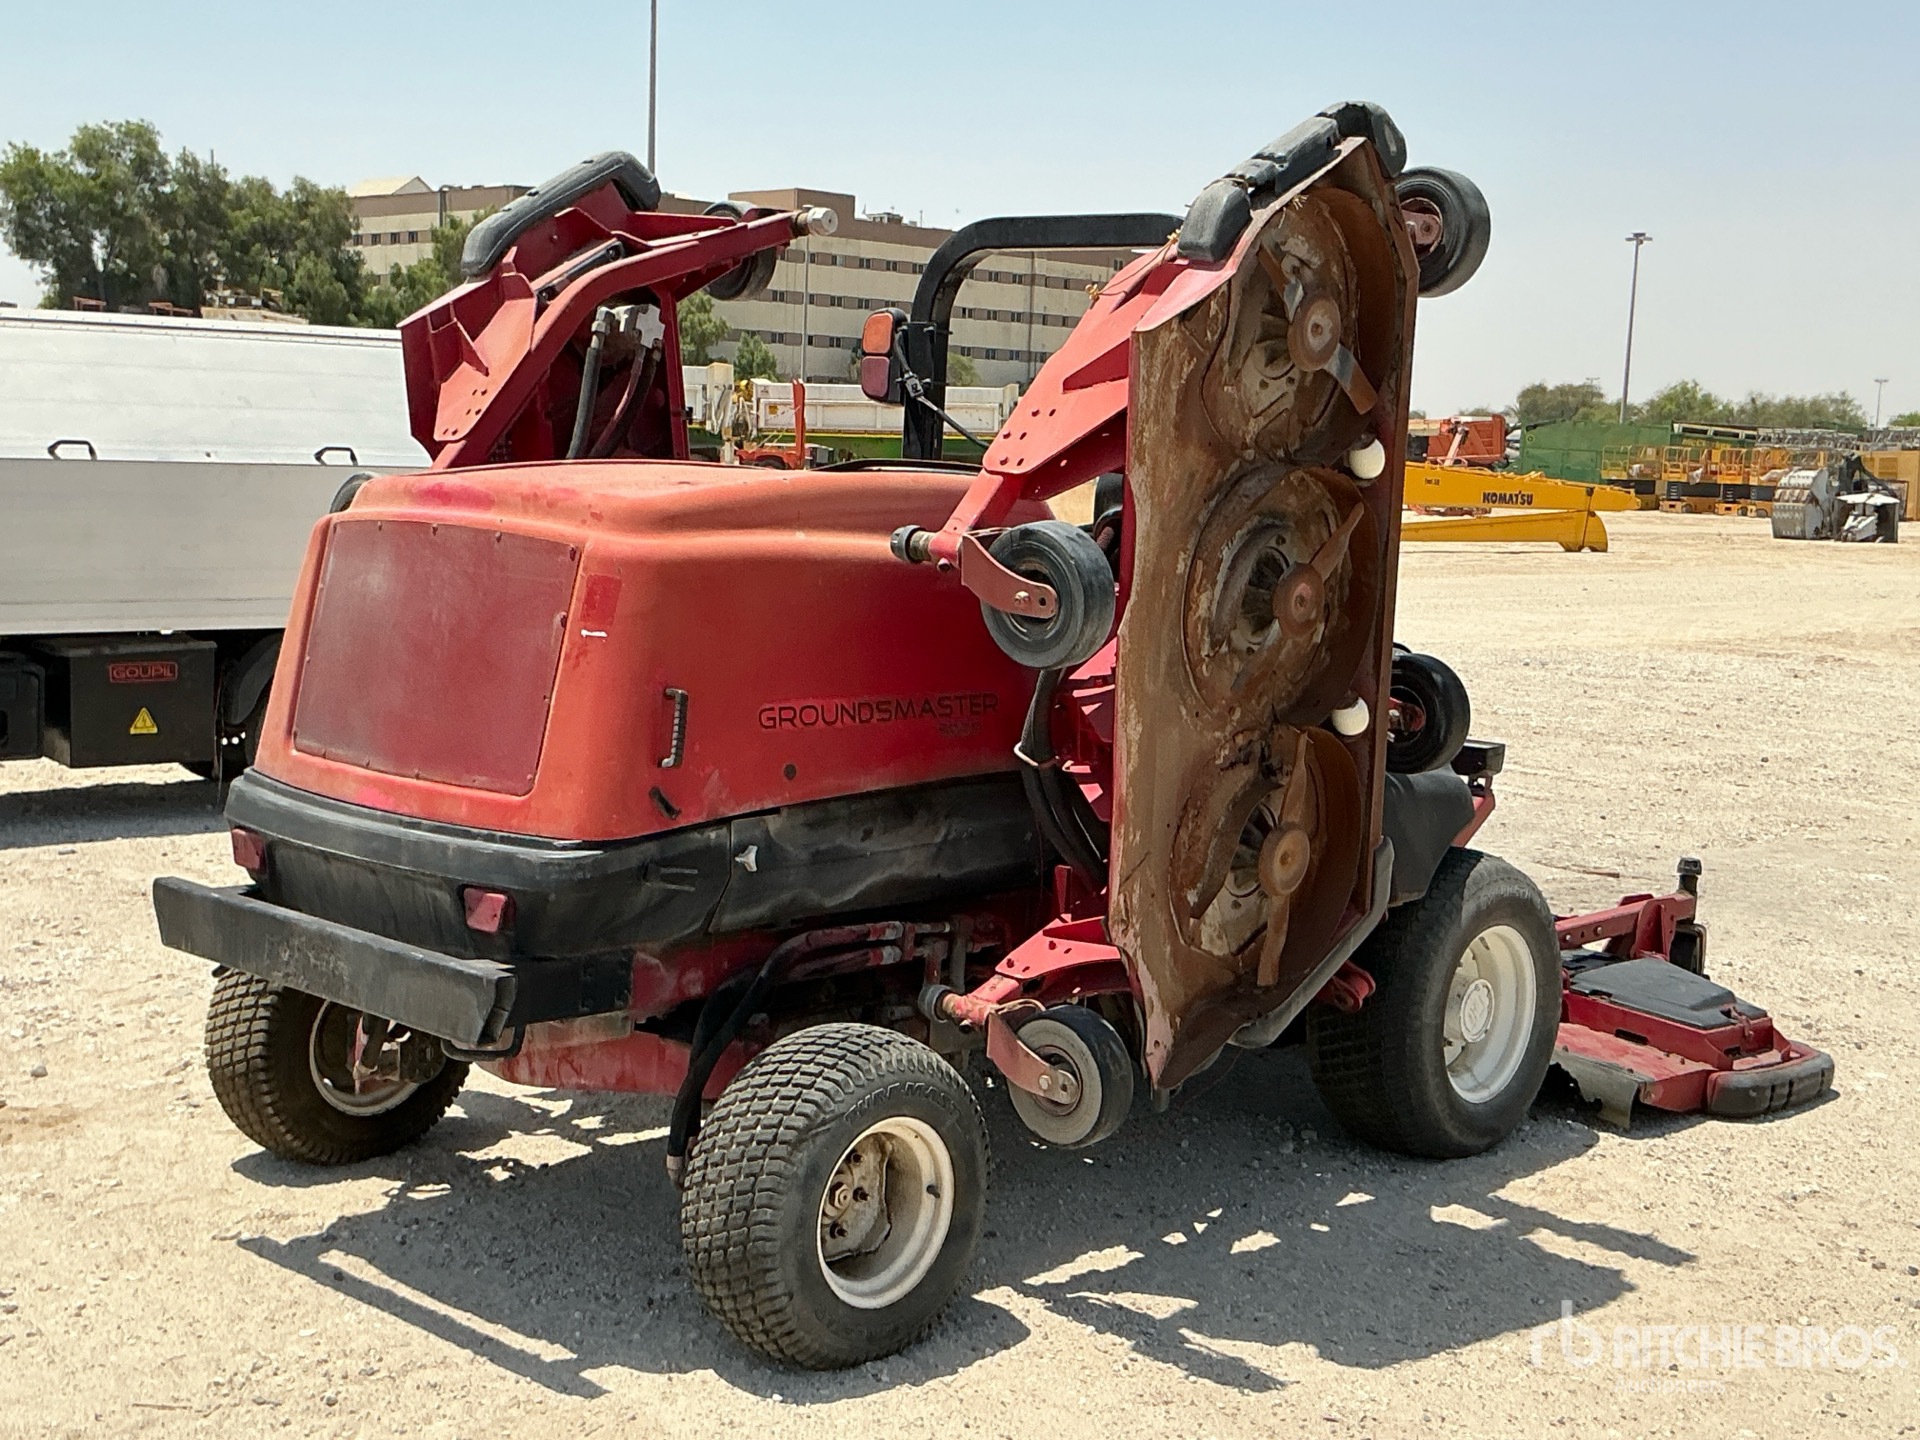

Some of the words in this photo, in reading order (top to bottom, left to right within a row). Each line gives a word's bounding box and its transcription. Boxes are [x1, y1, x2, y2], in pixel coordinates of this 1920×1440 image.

[1483, 490, 1534, 506] KOMATSU
[113, 664, 174, 679] GOUPIL
[758, 692, 1000, 730] GROUNDSMASTER
